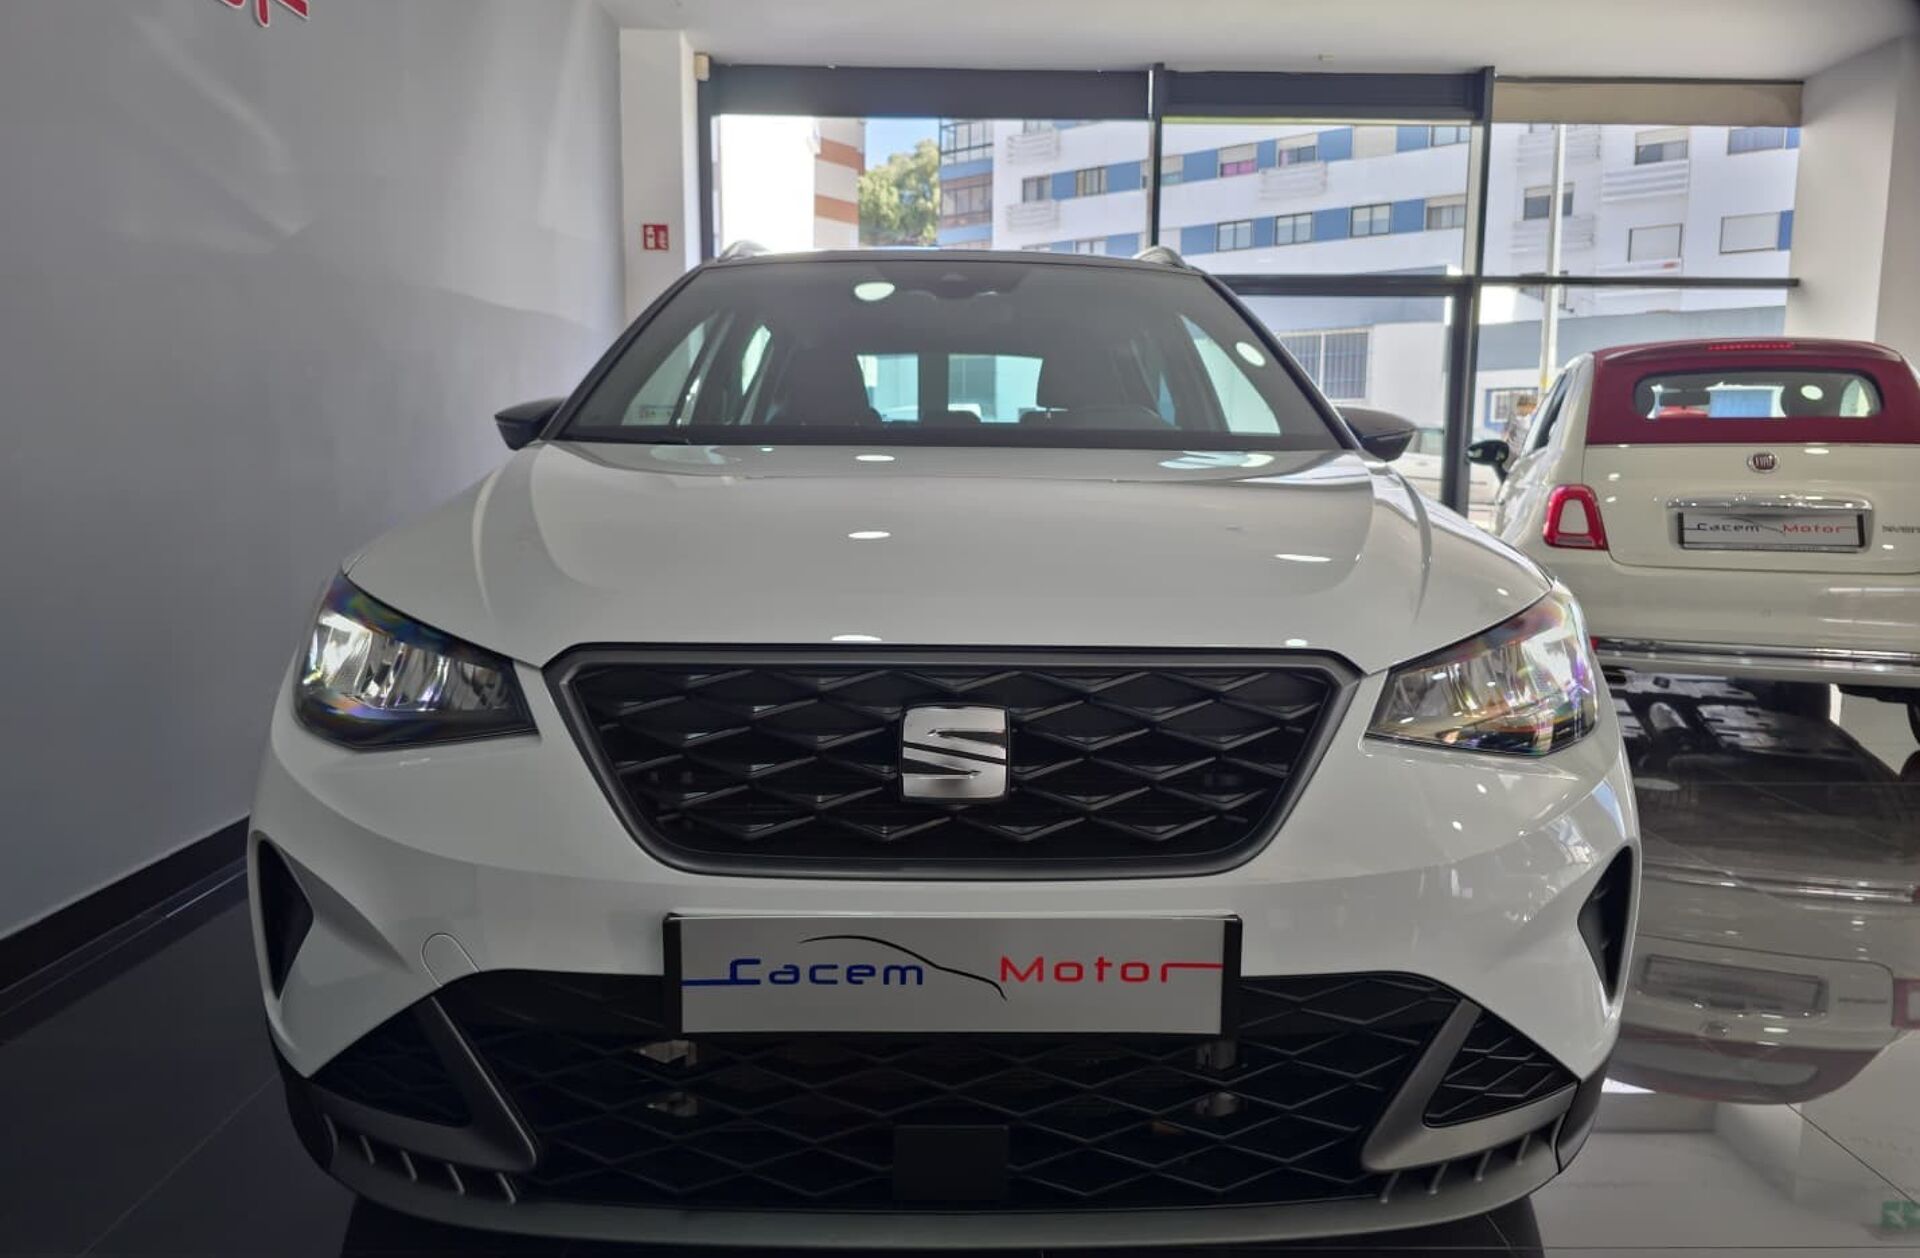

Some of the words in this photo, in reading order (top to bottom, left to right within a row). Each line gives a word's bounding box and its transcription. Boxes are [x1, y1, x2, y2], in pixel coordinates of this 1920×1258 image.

[1692, 521, 1761, 533] Cacem
[1782, 523, 1848, 534] Motor
[705, 957, 924, 987] Cacem
[1000, 955, 1221, 985] Motor
